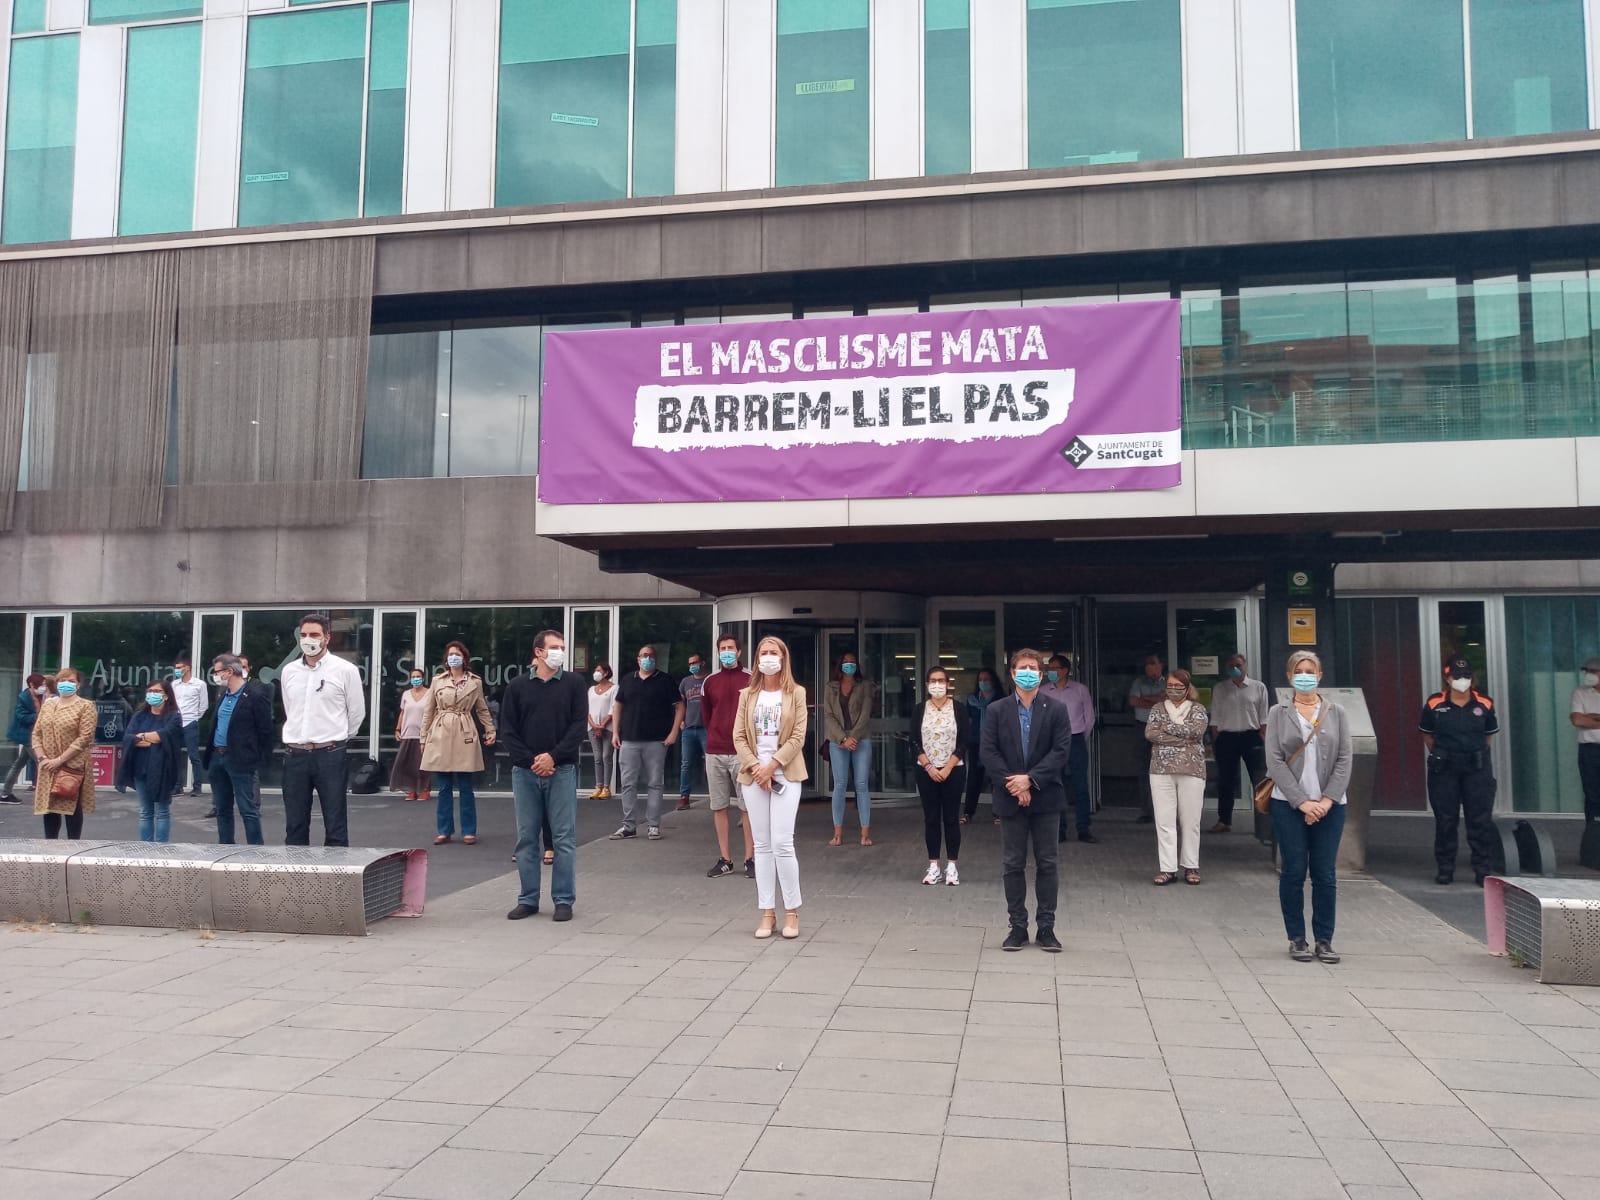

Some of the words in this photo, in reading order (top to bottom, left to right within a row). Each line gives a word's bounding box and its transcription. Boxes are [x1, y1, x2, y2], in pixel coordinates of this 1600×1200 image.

[660, 342, 703, 377] EL
[711, 331, 933, 376] MASCLISME
[941, 325, 1049, 365] MATA
[657, 387, 890, 434] BARREM-LI
[902, 385, 953, 427] EL
[963, 380, 1050, 424] PAS
[1097, 441, 1151, 449] AJUNTAMENT
[1152, 440, 1164, 448] DE
[1097, 448, 1164, 460] SantCugat
